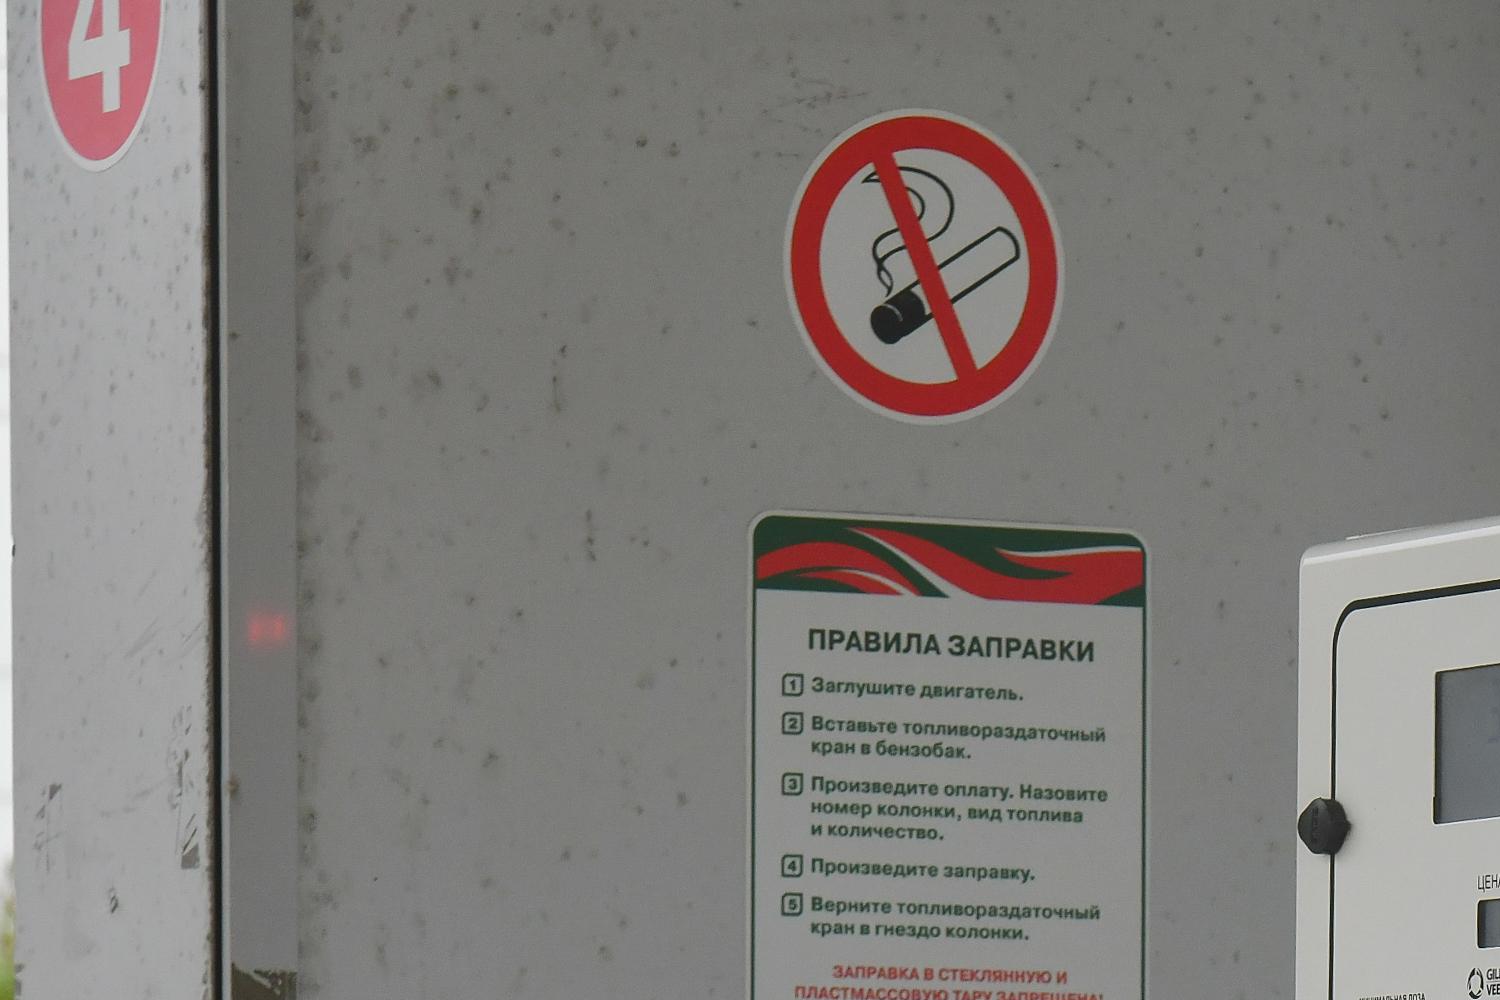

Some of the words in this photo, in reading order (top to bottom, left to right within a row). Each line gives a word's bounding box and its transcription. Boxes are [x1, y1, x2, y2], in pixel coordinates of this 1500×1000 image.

[68, 0, 130, 113] 4
[808, 628, 941, 656] ПРАВИЛА
[948, 634, 1095, 663] ЗАПРАВКИ
[811, 677, 916, 700] Заглушите
[919, 685, 1024, 701] двигатель.
[811, 716, 897, 734] Вставьте
[903, 722, 1106, 743] топливораздаточный
[811, 742, 856, 758] кран
[861, 744, 871, 756] в
[876, 739, 972, 759] бензобак.
[811, 776, 939, 797] Произведите
[944, 782, 1014, 801] оплату.
[1019, 784, 1108, 802] Назовите
[811, 801, 872, 818] номер
[877, 804, 963, 821] колонки,
[967, 807, 1002, 823] вид
[1007, 808, 1084, 823] топлива
[811, 824, 822, 836] и
[827, 824, 945, 840] количество.
[811, 858, 939, 878] Произведите
[943, 864, 1036, 883] заправку.
[811, 897, 892, 916] Верните
[897, 901, 1100, 922] топливораздаточный
[810, 923, 855, 937] кран
[860, 925, 870, 936] в
[875, 924, 941, 940] гнездо
[946, 926, 1029, 941] колонки.
[833, 965, 920, 981] ЗАПРАВКА
[924, 968, 934, 980] В
[939, 968, 1052, 984] СТЕКЛЯННУЮ
[1057, 971, 1067, 984] И
